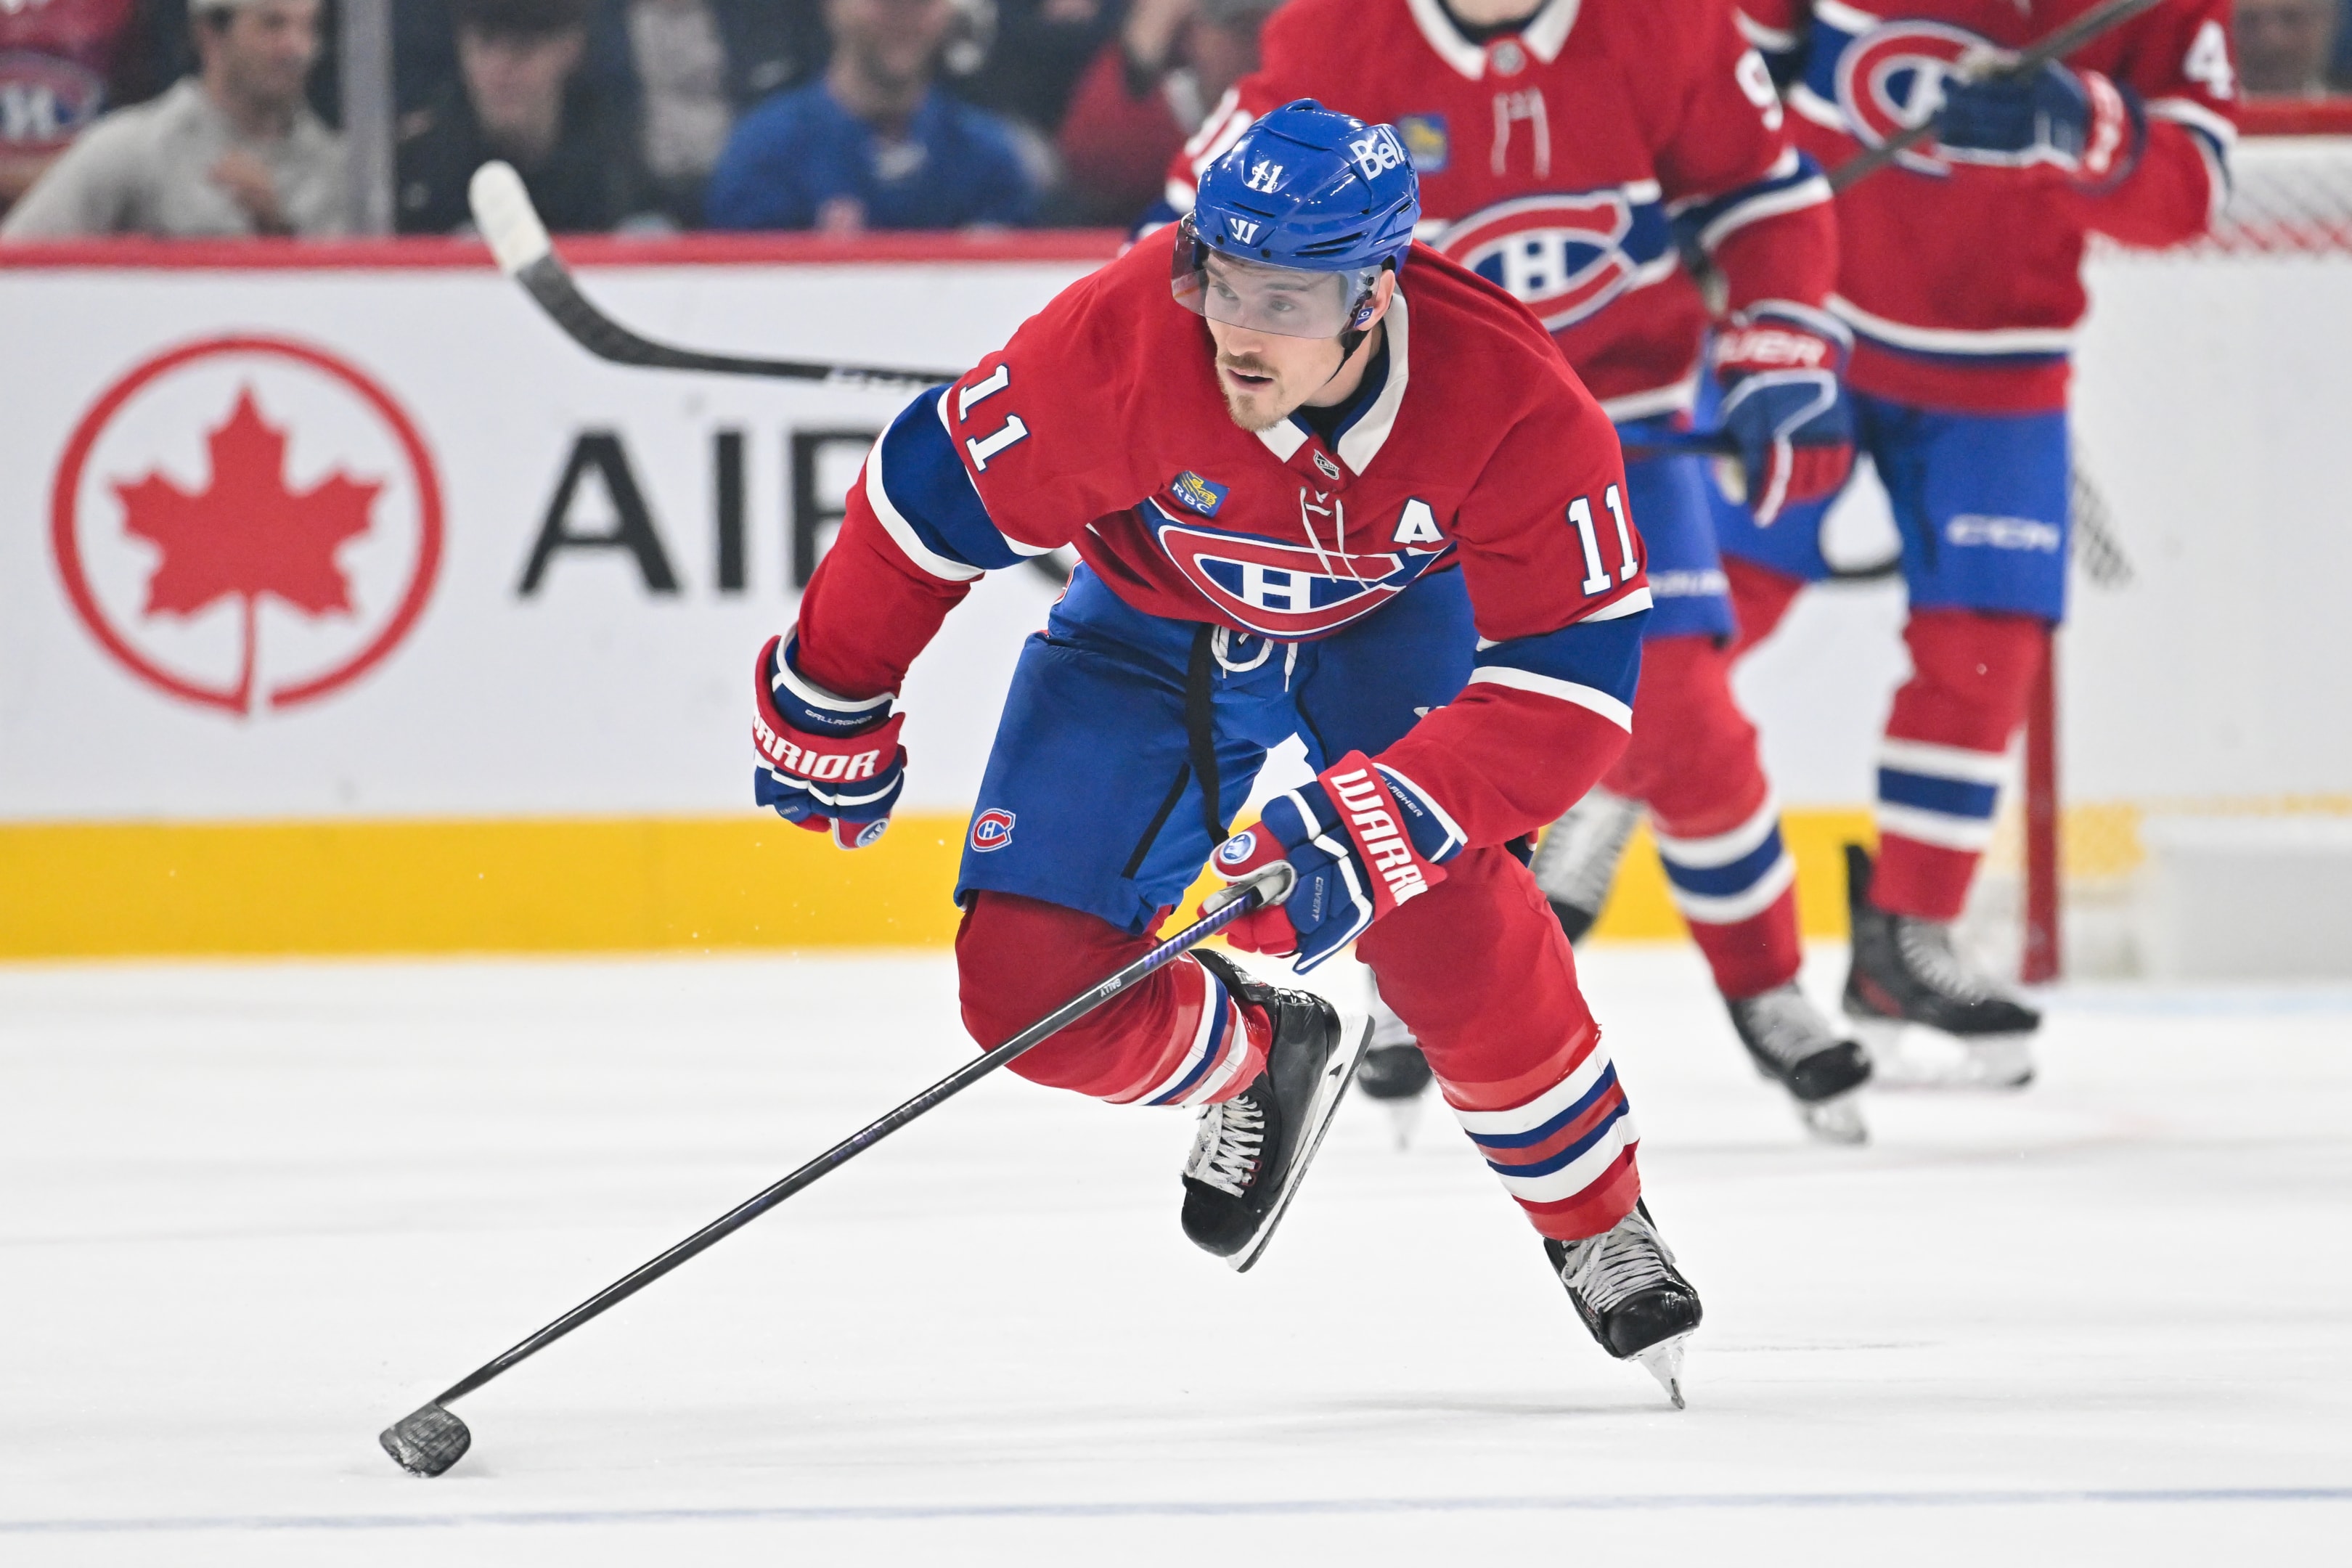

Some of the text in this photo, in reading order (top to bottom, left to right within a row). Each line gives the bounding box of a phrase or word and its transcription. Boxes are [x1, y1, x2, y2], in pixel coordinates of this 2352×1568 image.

[1349, 126, 1405, 181] Bell
[1251, 160, 1284, 194] 11
[959, 364, 1029, 472] 11
[1172, 482, 1209, 513] RBC
[1394, 499, 1445, 544] A
[1568, 484, 1638, 595] 11
[804, 709, 873, 726] GALLAGHER
[1312, 876, 1324, 923] COVERT
[1100, 978, 1122, 998] GALLY
